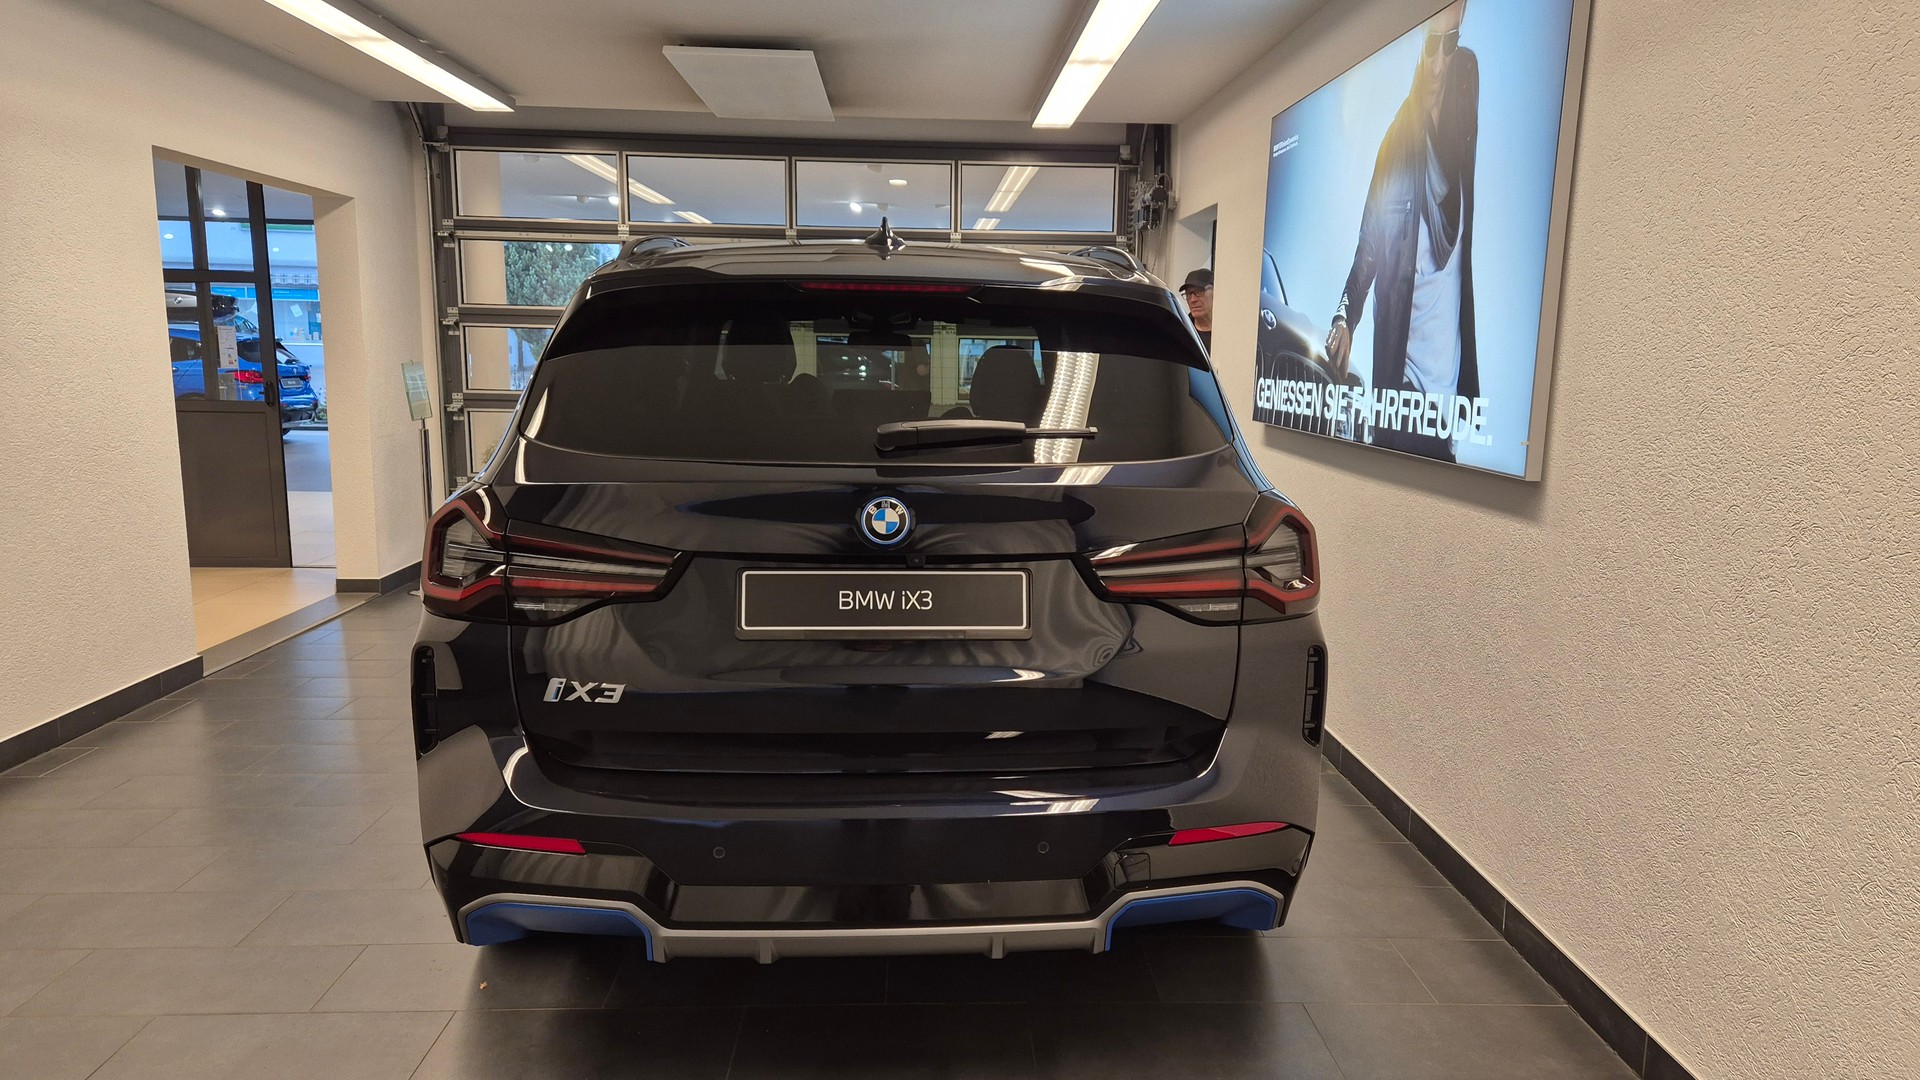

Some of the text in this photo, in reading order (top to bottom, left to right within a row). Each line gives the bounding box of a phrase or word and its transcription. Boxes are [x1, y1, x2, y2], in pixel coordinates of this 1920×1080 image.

[1256, 377, 1493, 447] GENIESSEN SIE FAHRFREUDE.
[868, 500, 904, 515] BMW
[839, 590, 933, 610] BMW iX3
[543, 677, 626, 704] iX3
